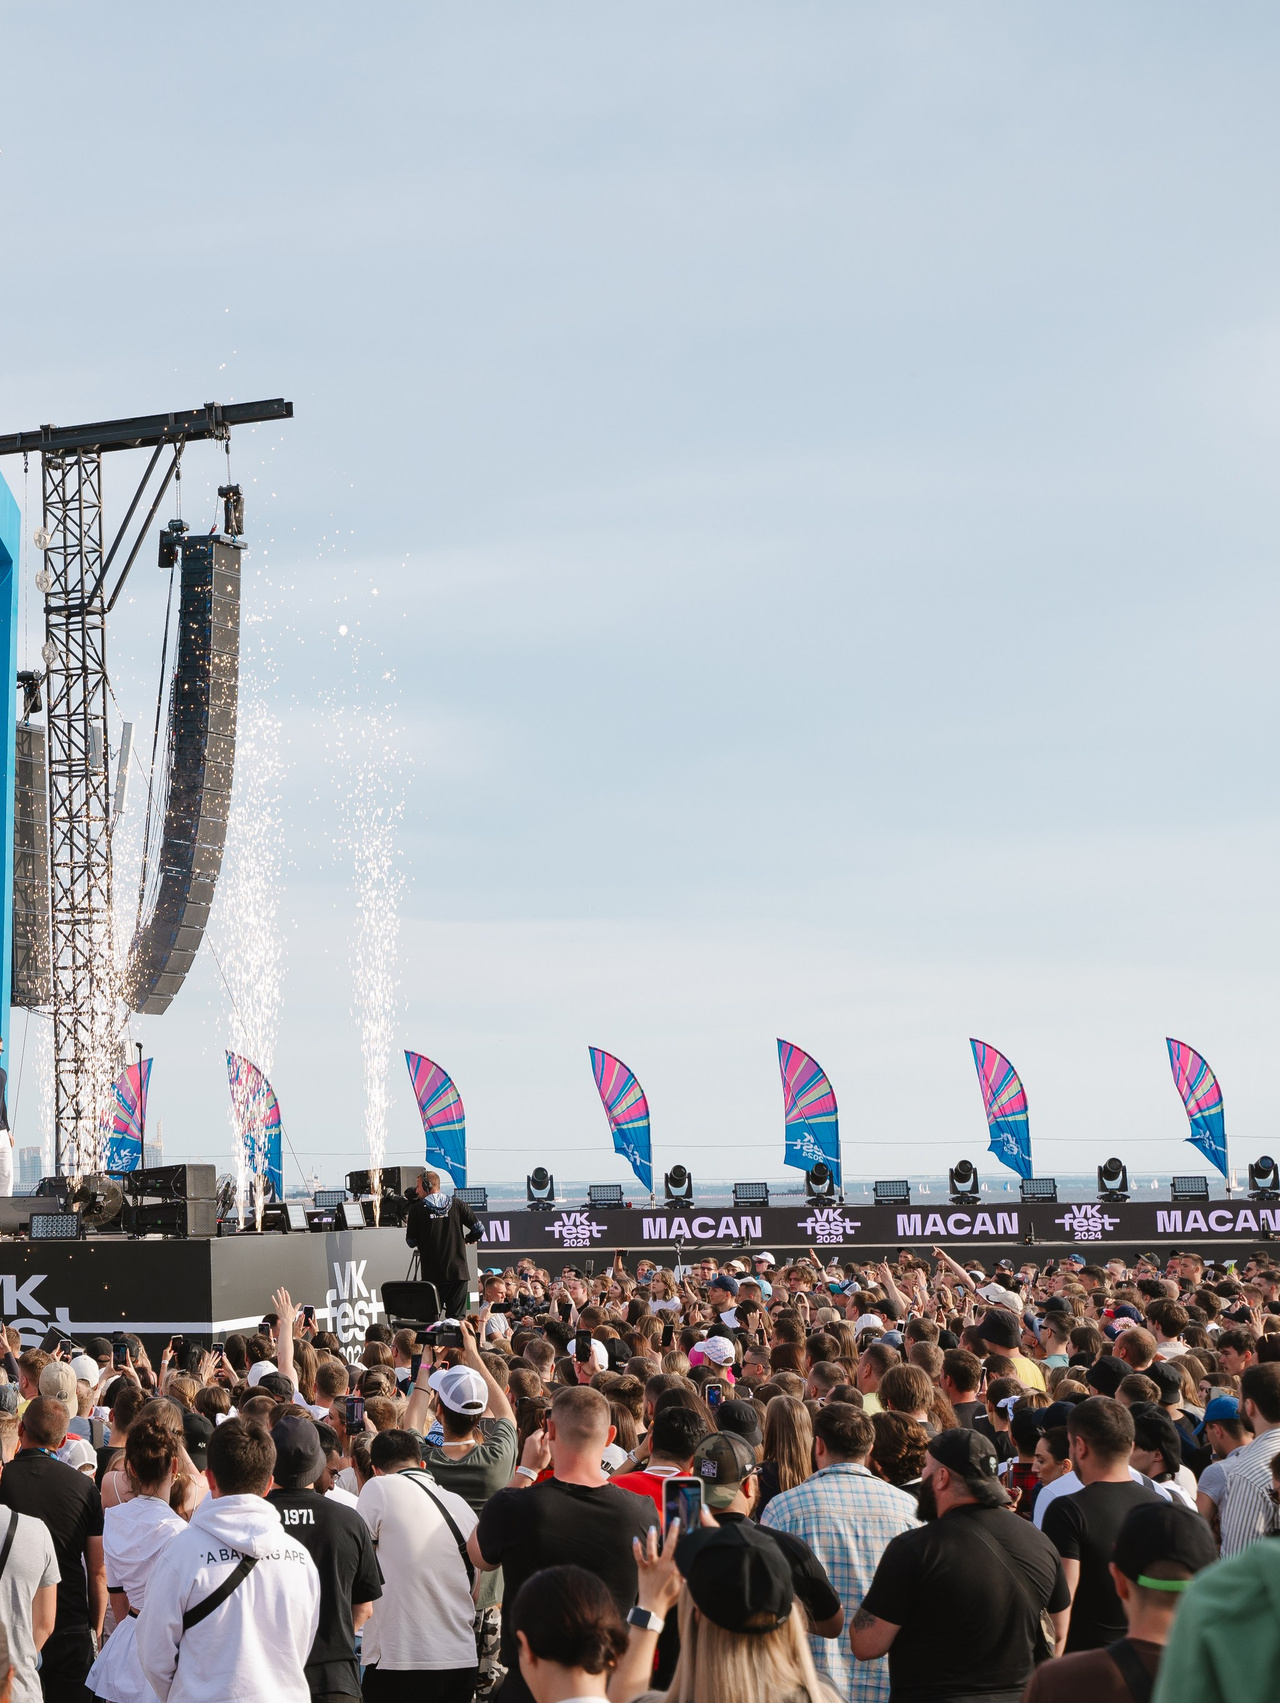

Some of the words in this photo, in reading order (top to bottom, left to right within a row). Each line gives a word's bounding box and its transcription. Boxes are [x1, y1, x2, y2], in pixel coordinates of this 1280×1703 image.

[561, 1212, 590, 1226] VK
[813, 1208, 844, 1221] VK
[1071, 1204, 1103, 1218] VK
[553, 1220, 602, 1239] fest
[642, 1216, 762, 1240] MACAN
[806, 1217, 856, 1235] fest
[896, 1212, 1019, 1236] MACAN
[1063, 1213, 1114, 1231] fest
[563, 1238, 591, 1247] 2024
[816, 1234, 844, 1244] 2024
[1074, 1231, 1103, 1240] 2024
[333, 1259, 370, 1299] VK
[326, 1288, 377, 1343] fest
[283, 1509, 315, 1525] 1971
[284, 1549, 306, 1565] APE
